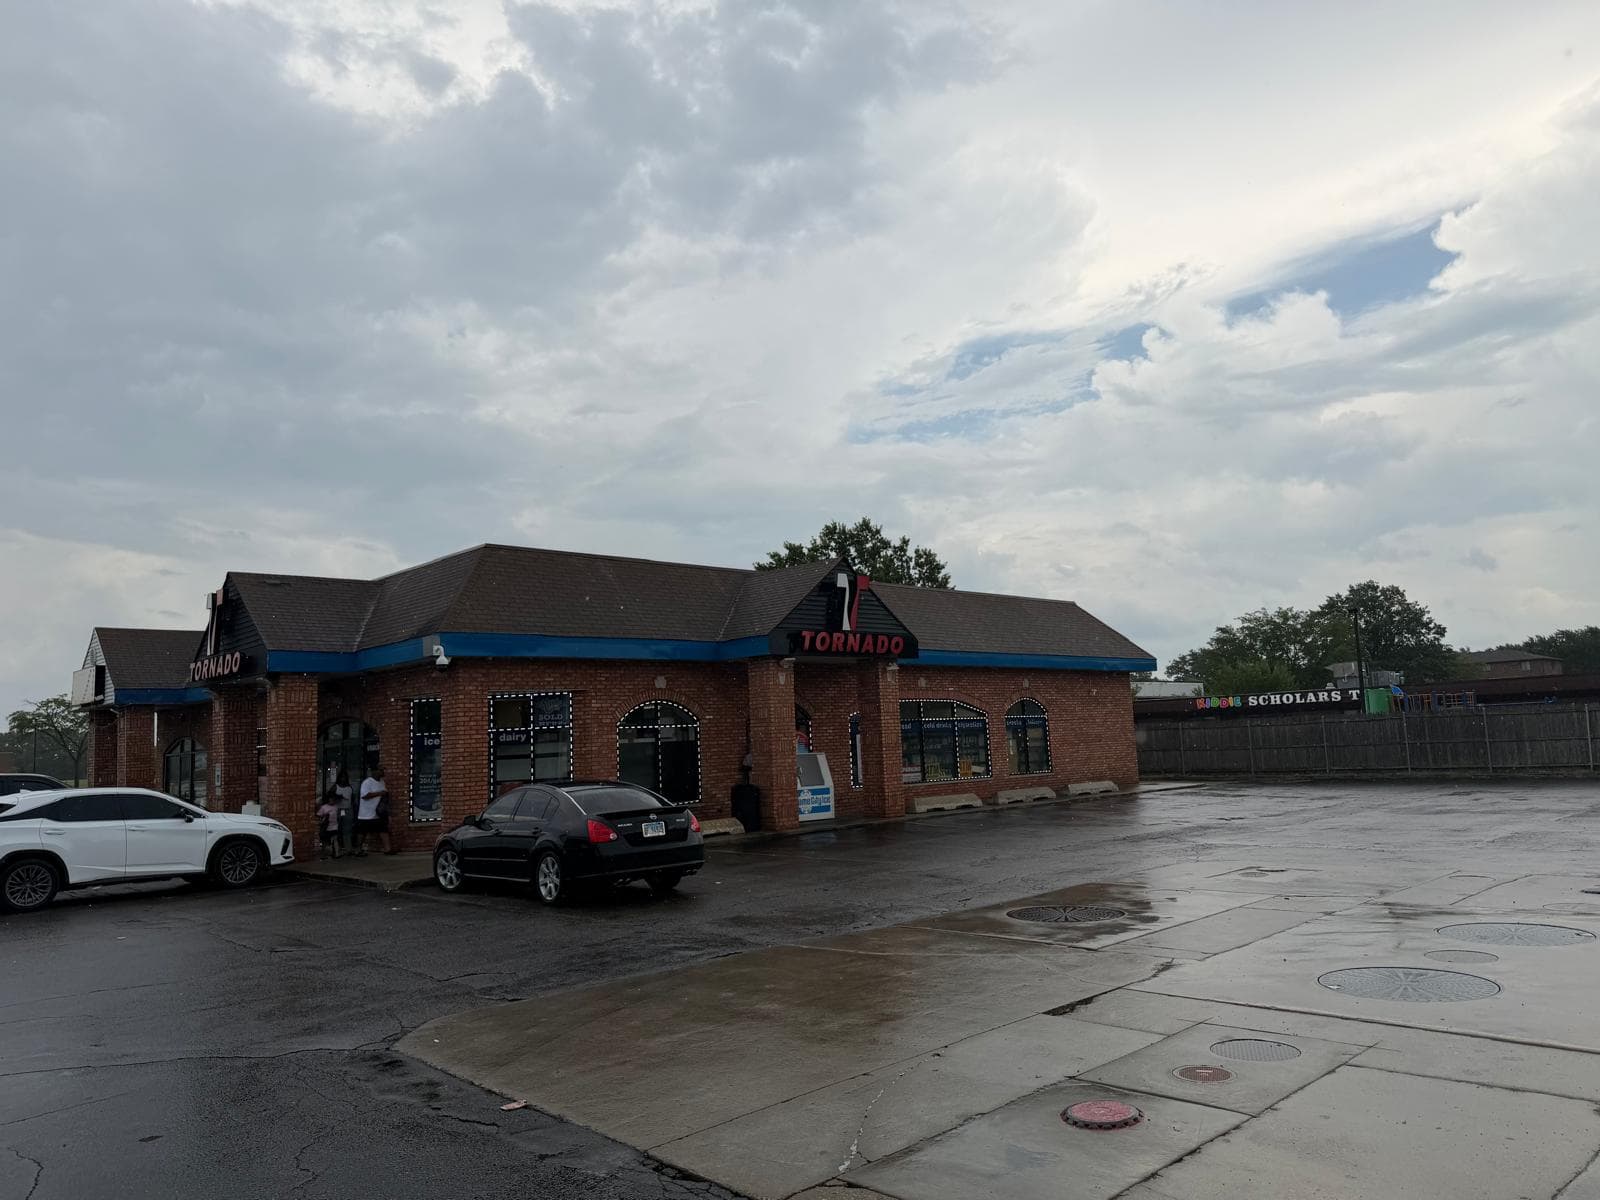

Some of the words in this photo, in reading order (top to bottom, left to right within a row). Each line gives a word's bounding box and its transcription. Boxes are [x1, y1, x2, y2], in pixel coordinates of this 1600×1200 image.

[801, 630, 904, 654] TORNADO
[189, 651, 241, 682] TORNADO
[1196, 696, 1242, 709] KIDDIE
[1248, 690, 1342, 707] SCHOLARS
[424, 737, 440, 746] ice
[498, 732, 526, 743] dairy
